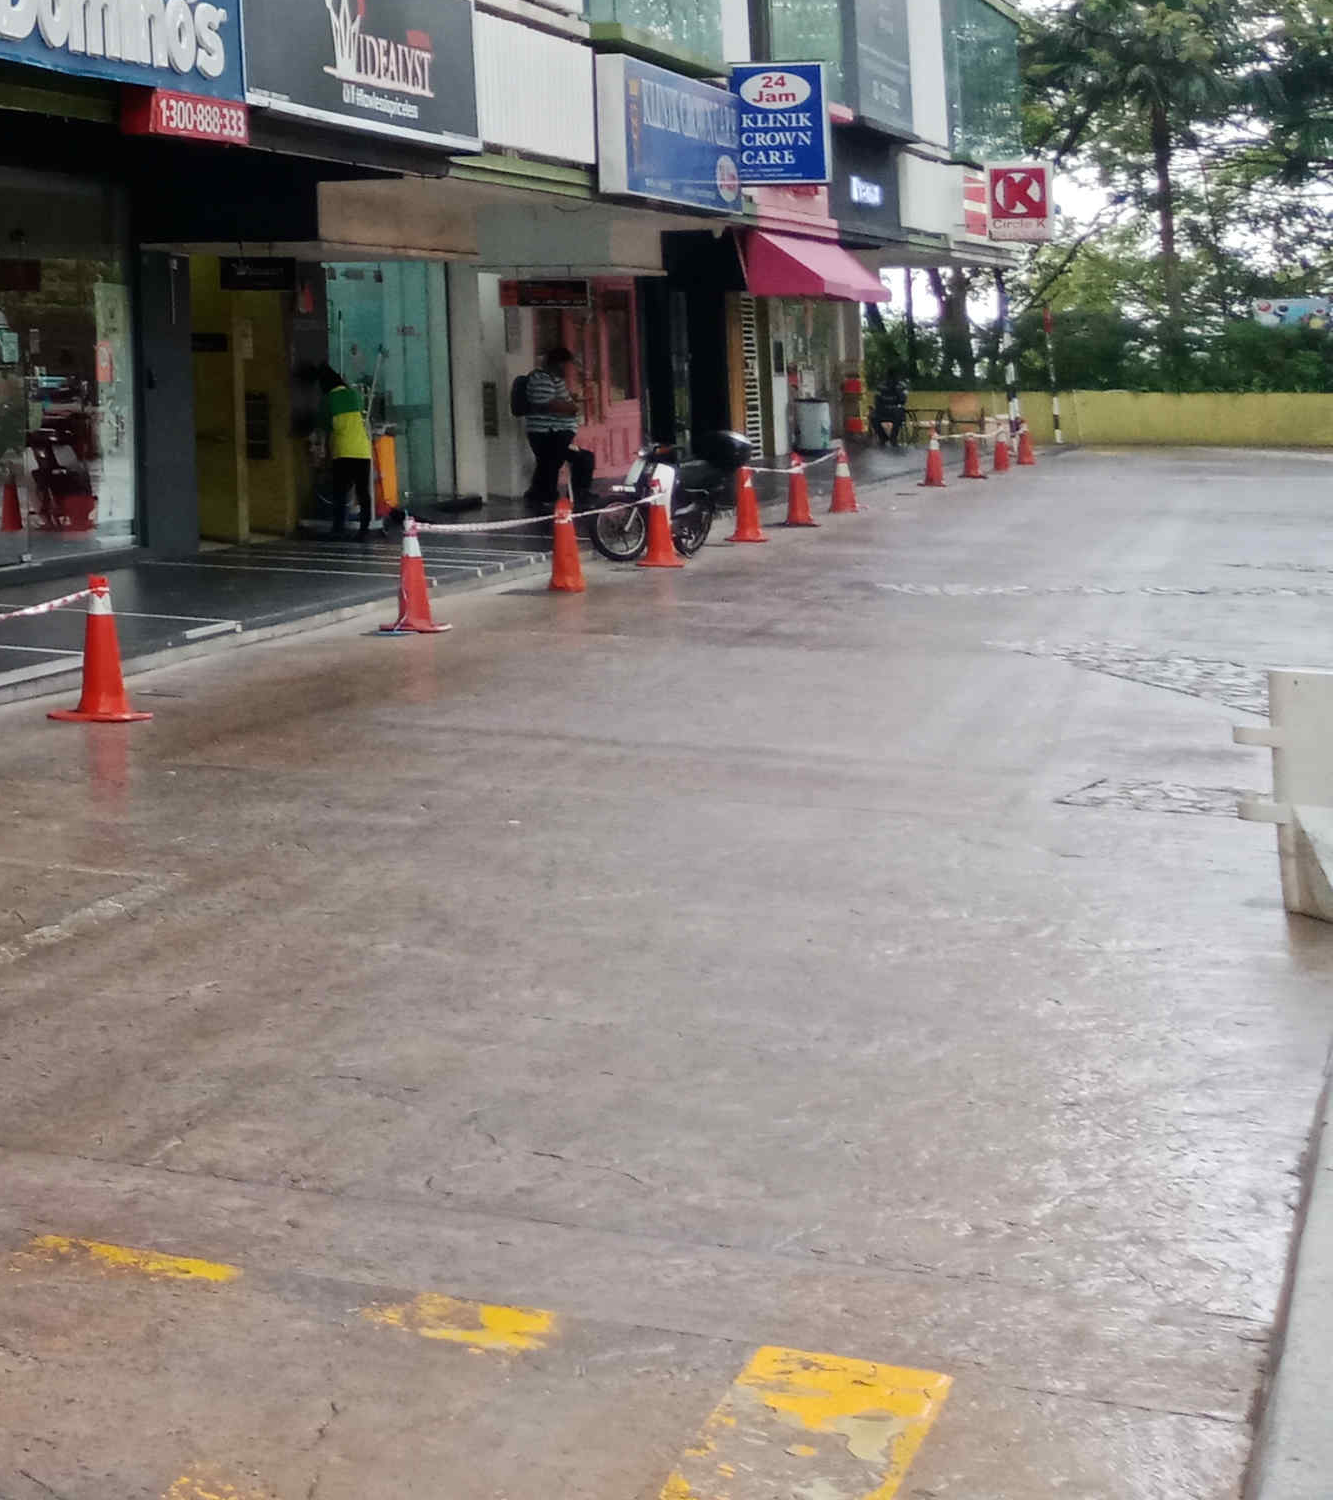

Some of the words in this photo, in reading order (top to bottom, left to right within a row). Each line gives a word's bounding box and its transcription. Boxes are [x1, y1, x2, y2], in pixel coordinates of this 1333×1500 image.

[359, 33, 432, 94] IDEALYST
[761, 75, 786, 88] 24
[752, 90, 797, 104] Jam
[159, 98, 245, 138] 1-300-888-333
[741, 112, 813, 128] KLINIK
[741, 131, 813, 146] CROWN
[742, 149, 796, 165] CARE
[993, 219, 1031, 229] Circle
[1036, 219, 1046, 229] K
